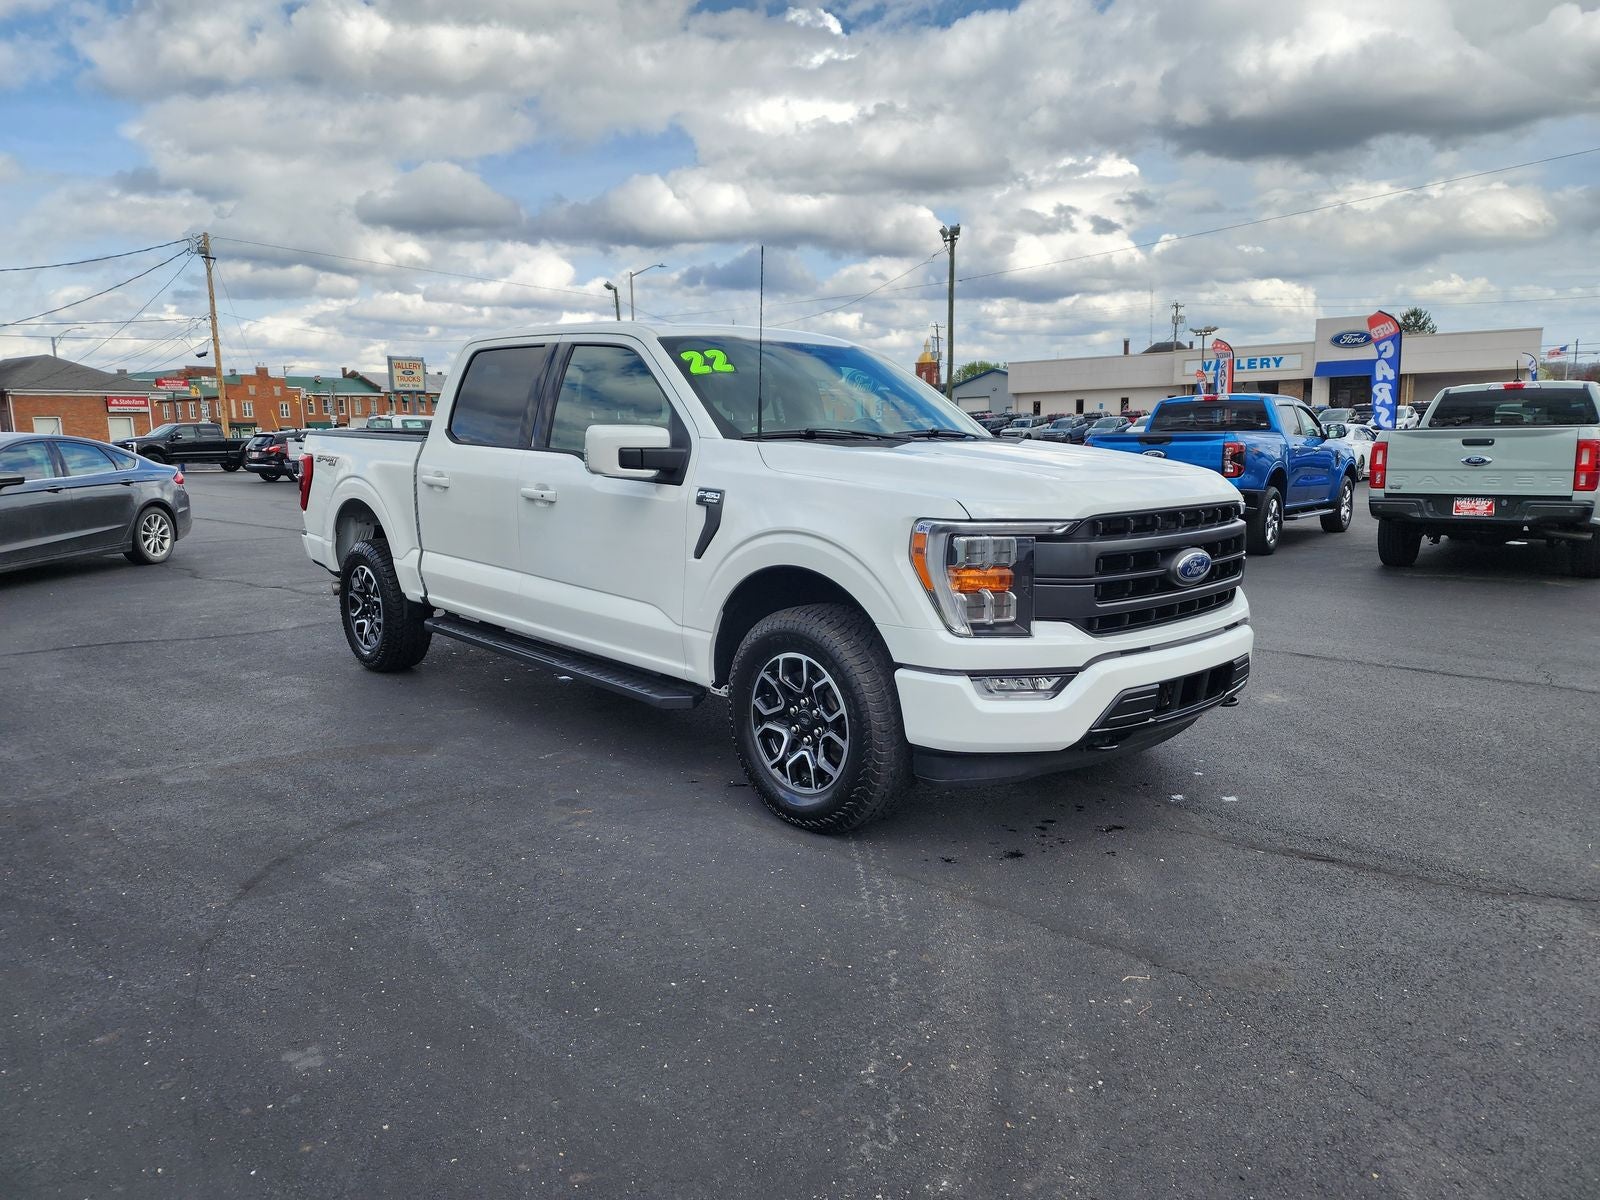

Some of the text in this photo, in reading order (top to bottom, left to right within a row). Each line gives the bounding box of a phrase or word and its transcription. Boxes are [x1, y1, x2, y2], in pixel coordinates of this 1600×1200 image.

[1340, 333, 1367, 344] Ford
[393, 362, 422, 370] VALLERY
[680, 349, 735, 375] 22
[1203, 356, 1284, 372] VLERY
[1392, 475, 1567, 487] RANGER
[1186, 557, 1207, 576] Ford
